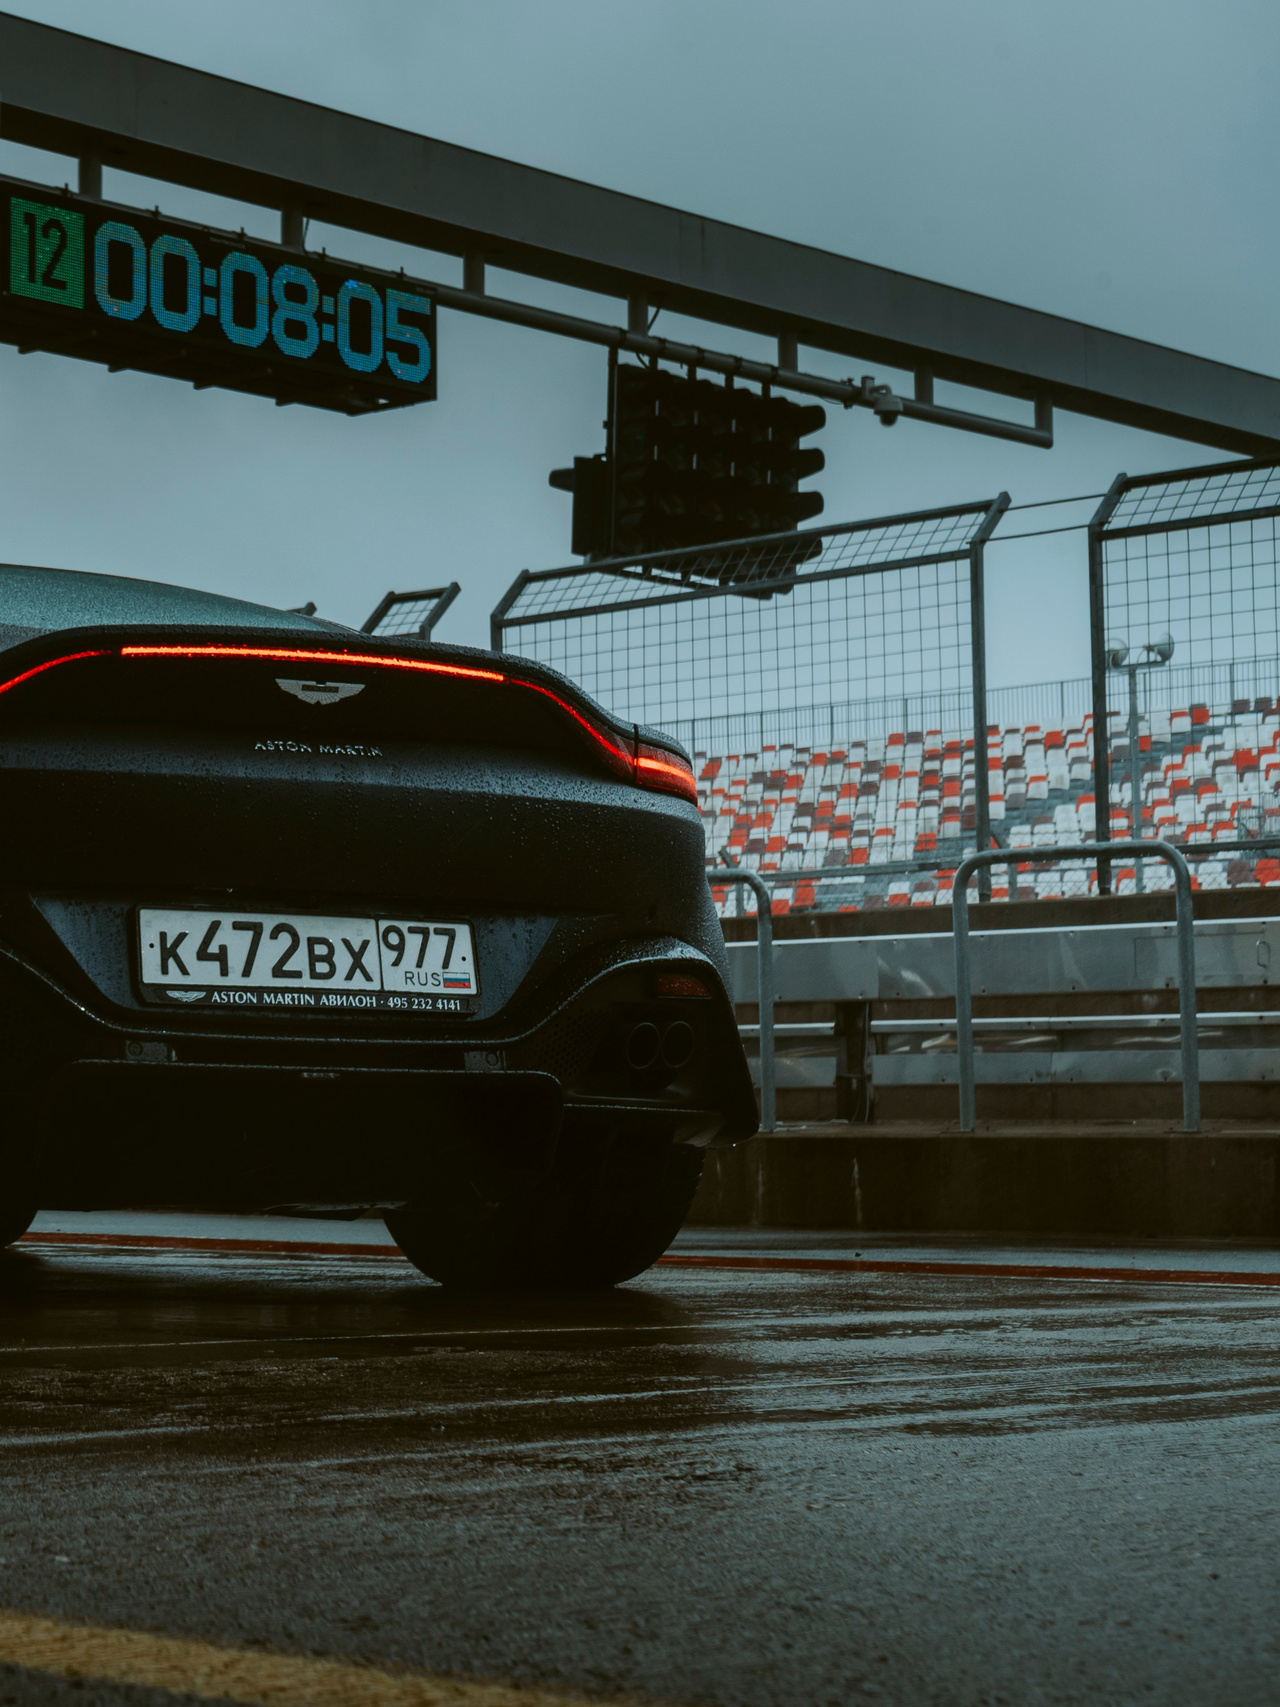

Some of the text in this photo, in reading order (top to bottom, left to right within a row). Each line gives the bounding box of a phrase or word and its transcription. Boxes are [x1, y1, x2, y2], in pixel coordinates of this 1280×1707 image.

[24, 212, 431, 383] 12 00:08:05
[254, 740, 382, 756] ASTON MARTIN
[382, 925, 456, 970] 977
[405, 971, 442, 987] RUS
[211, 991, 258, 1004] ASTON
[263, 992, 315, 1006] MARTIN
[387, 997, 408, 1009] 495
[411, 998, 433, 1010] 232
[435, 999, 461, 1011] 4141
